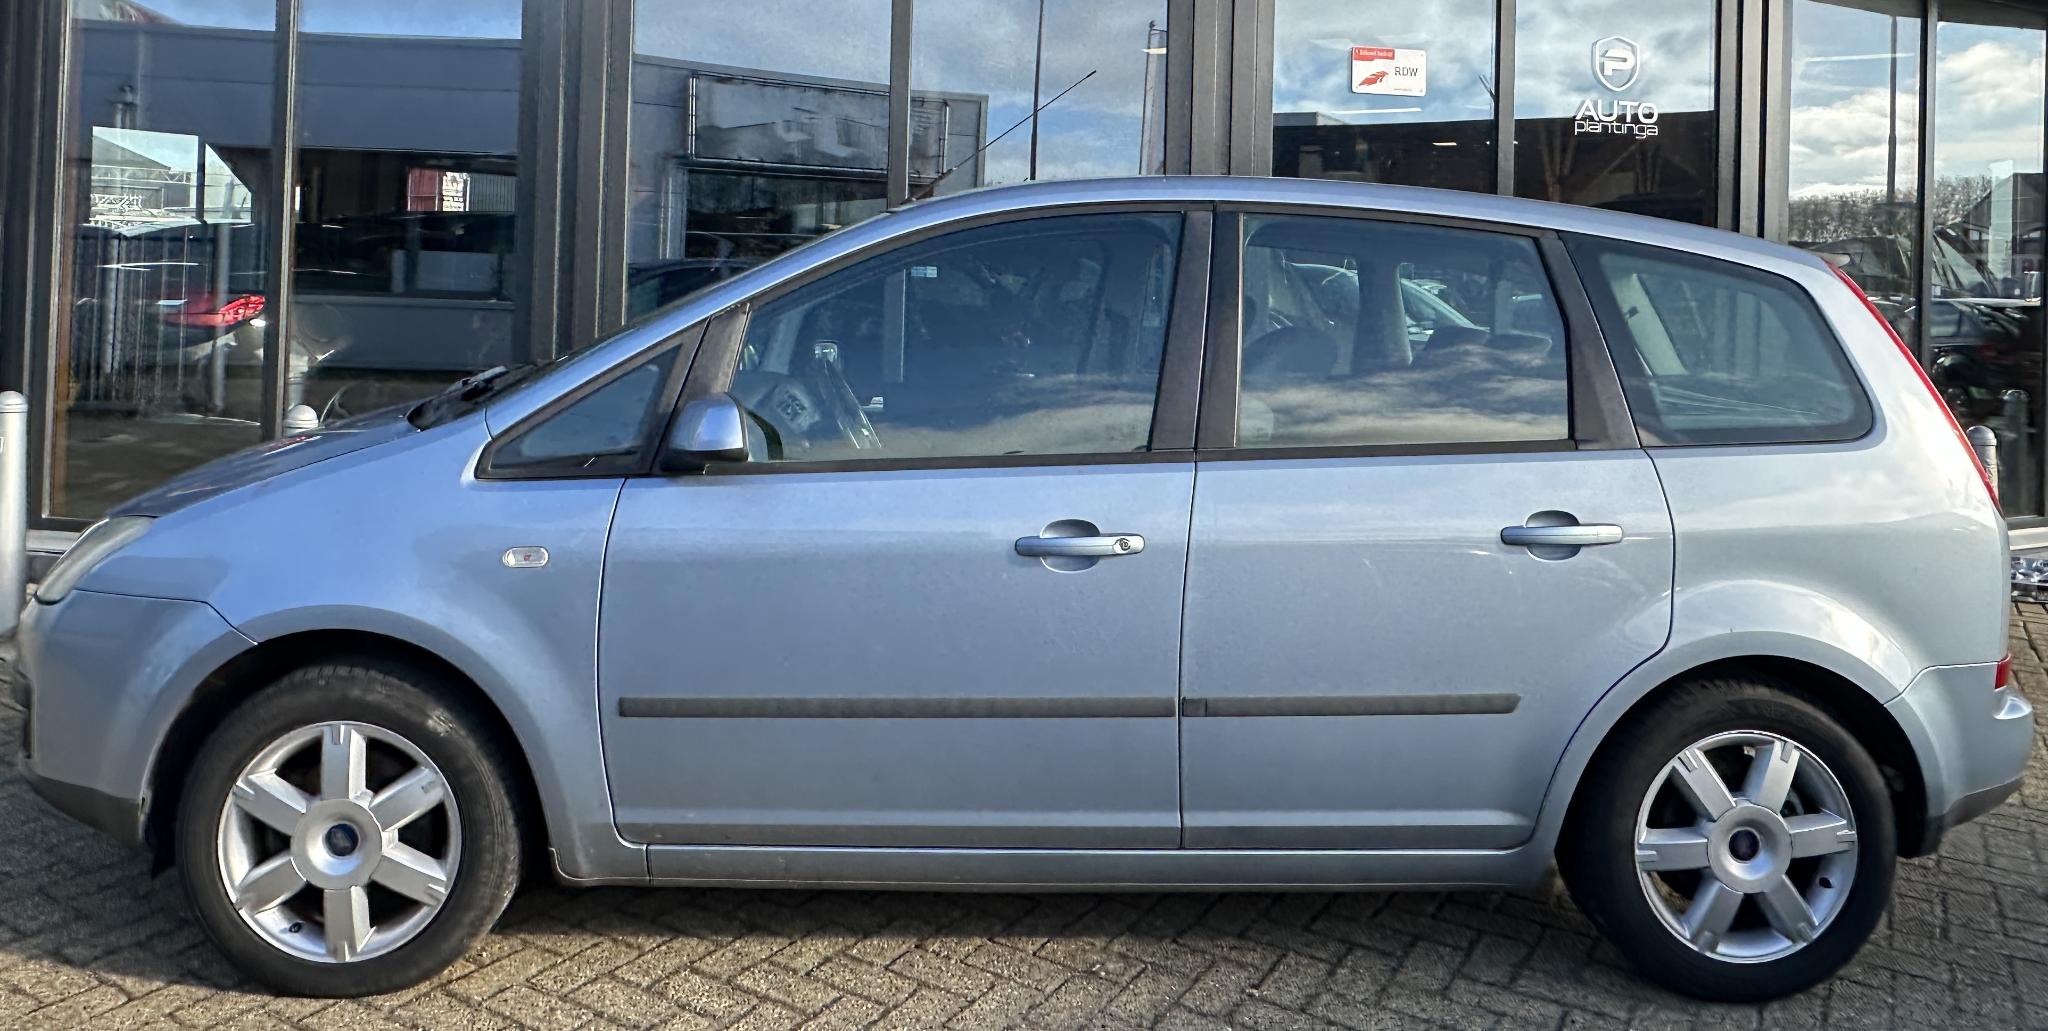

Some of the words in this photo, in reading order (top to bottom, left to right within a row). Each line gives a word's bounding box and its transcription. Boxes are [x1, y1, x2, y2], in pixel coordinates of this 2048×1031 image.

[1394, 66, 1418, 77] RDW
[1575, 99, 1659, 124] AUTO
[1574, 119, 1659, 139] plantinga
